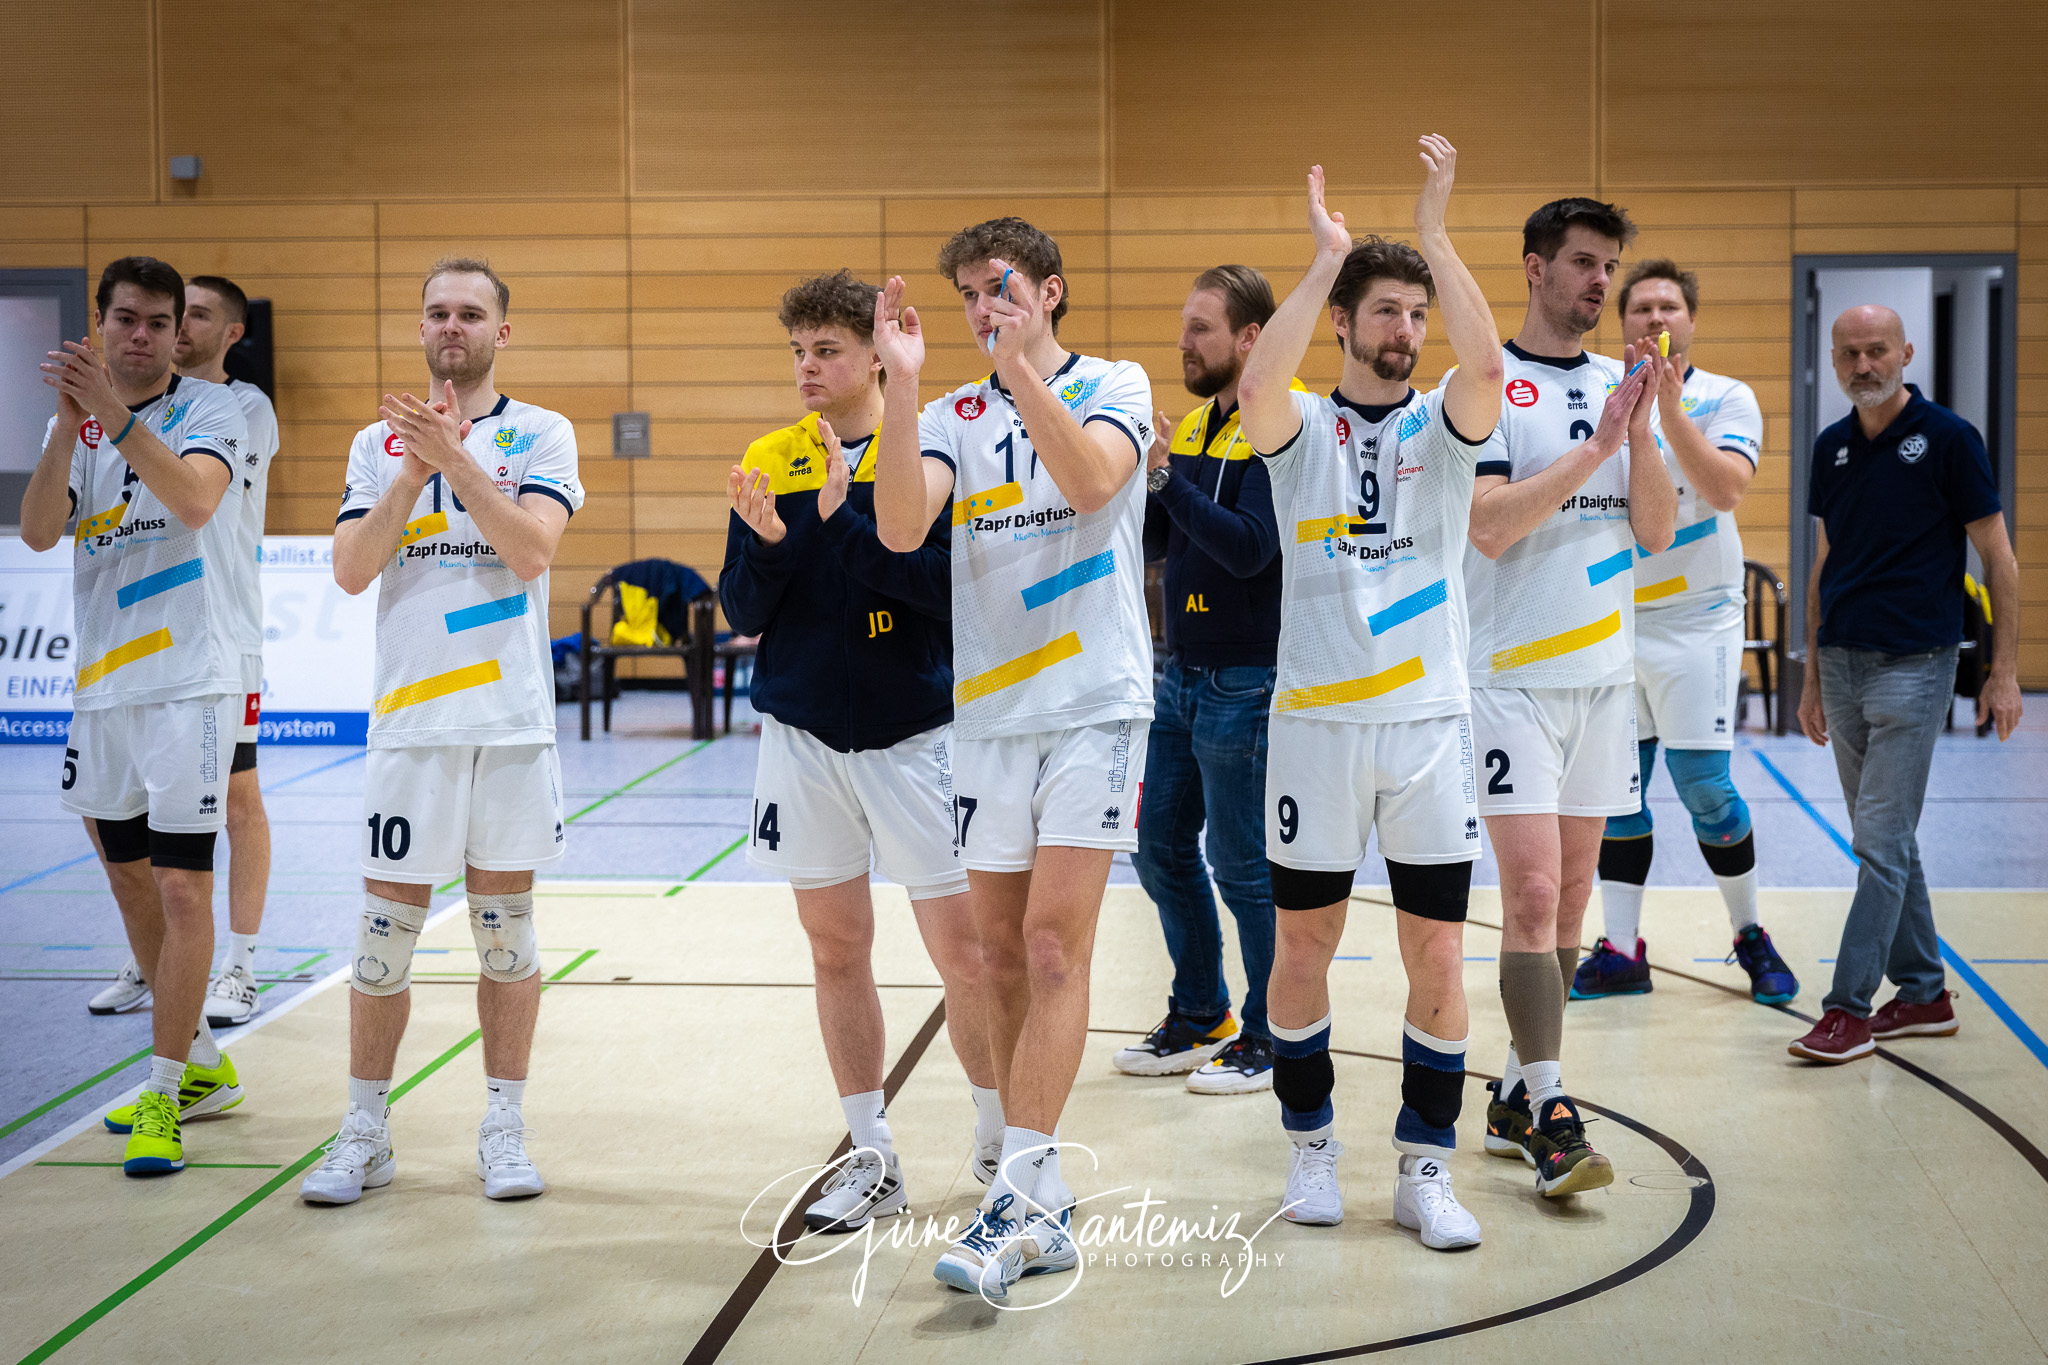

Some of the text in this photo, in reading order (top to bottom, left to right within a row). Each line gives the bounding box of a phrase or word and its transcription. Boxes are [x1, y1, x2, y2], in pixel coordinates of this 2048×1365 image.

[1567, 402, 1588, 410] errea
[789, 467, 812, 477] errea
[1397, 465, 1425, 477] elmann
[1358, 470, 1380, 520] 9
[974, 515, 1012, 533] Zapf
[406, 543, 437, 559] Zapf
[1186, 593, 1210, 613] AL
[868, 610, 893, 638] JD
[8, 676, 76, 698] EINFA
[61, 747, 79, 790] 5
[1485, 748, 1514, 795] 2
[199, 807, 218, 815] errea
[1278, 794, 1299, 844] 9
[1101, 820, 1119, 829] errea
[367, 812, 411, 861] 10
[369, 926, 389, 938] errea
